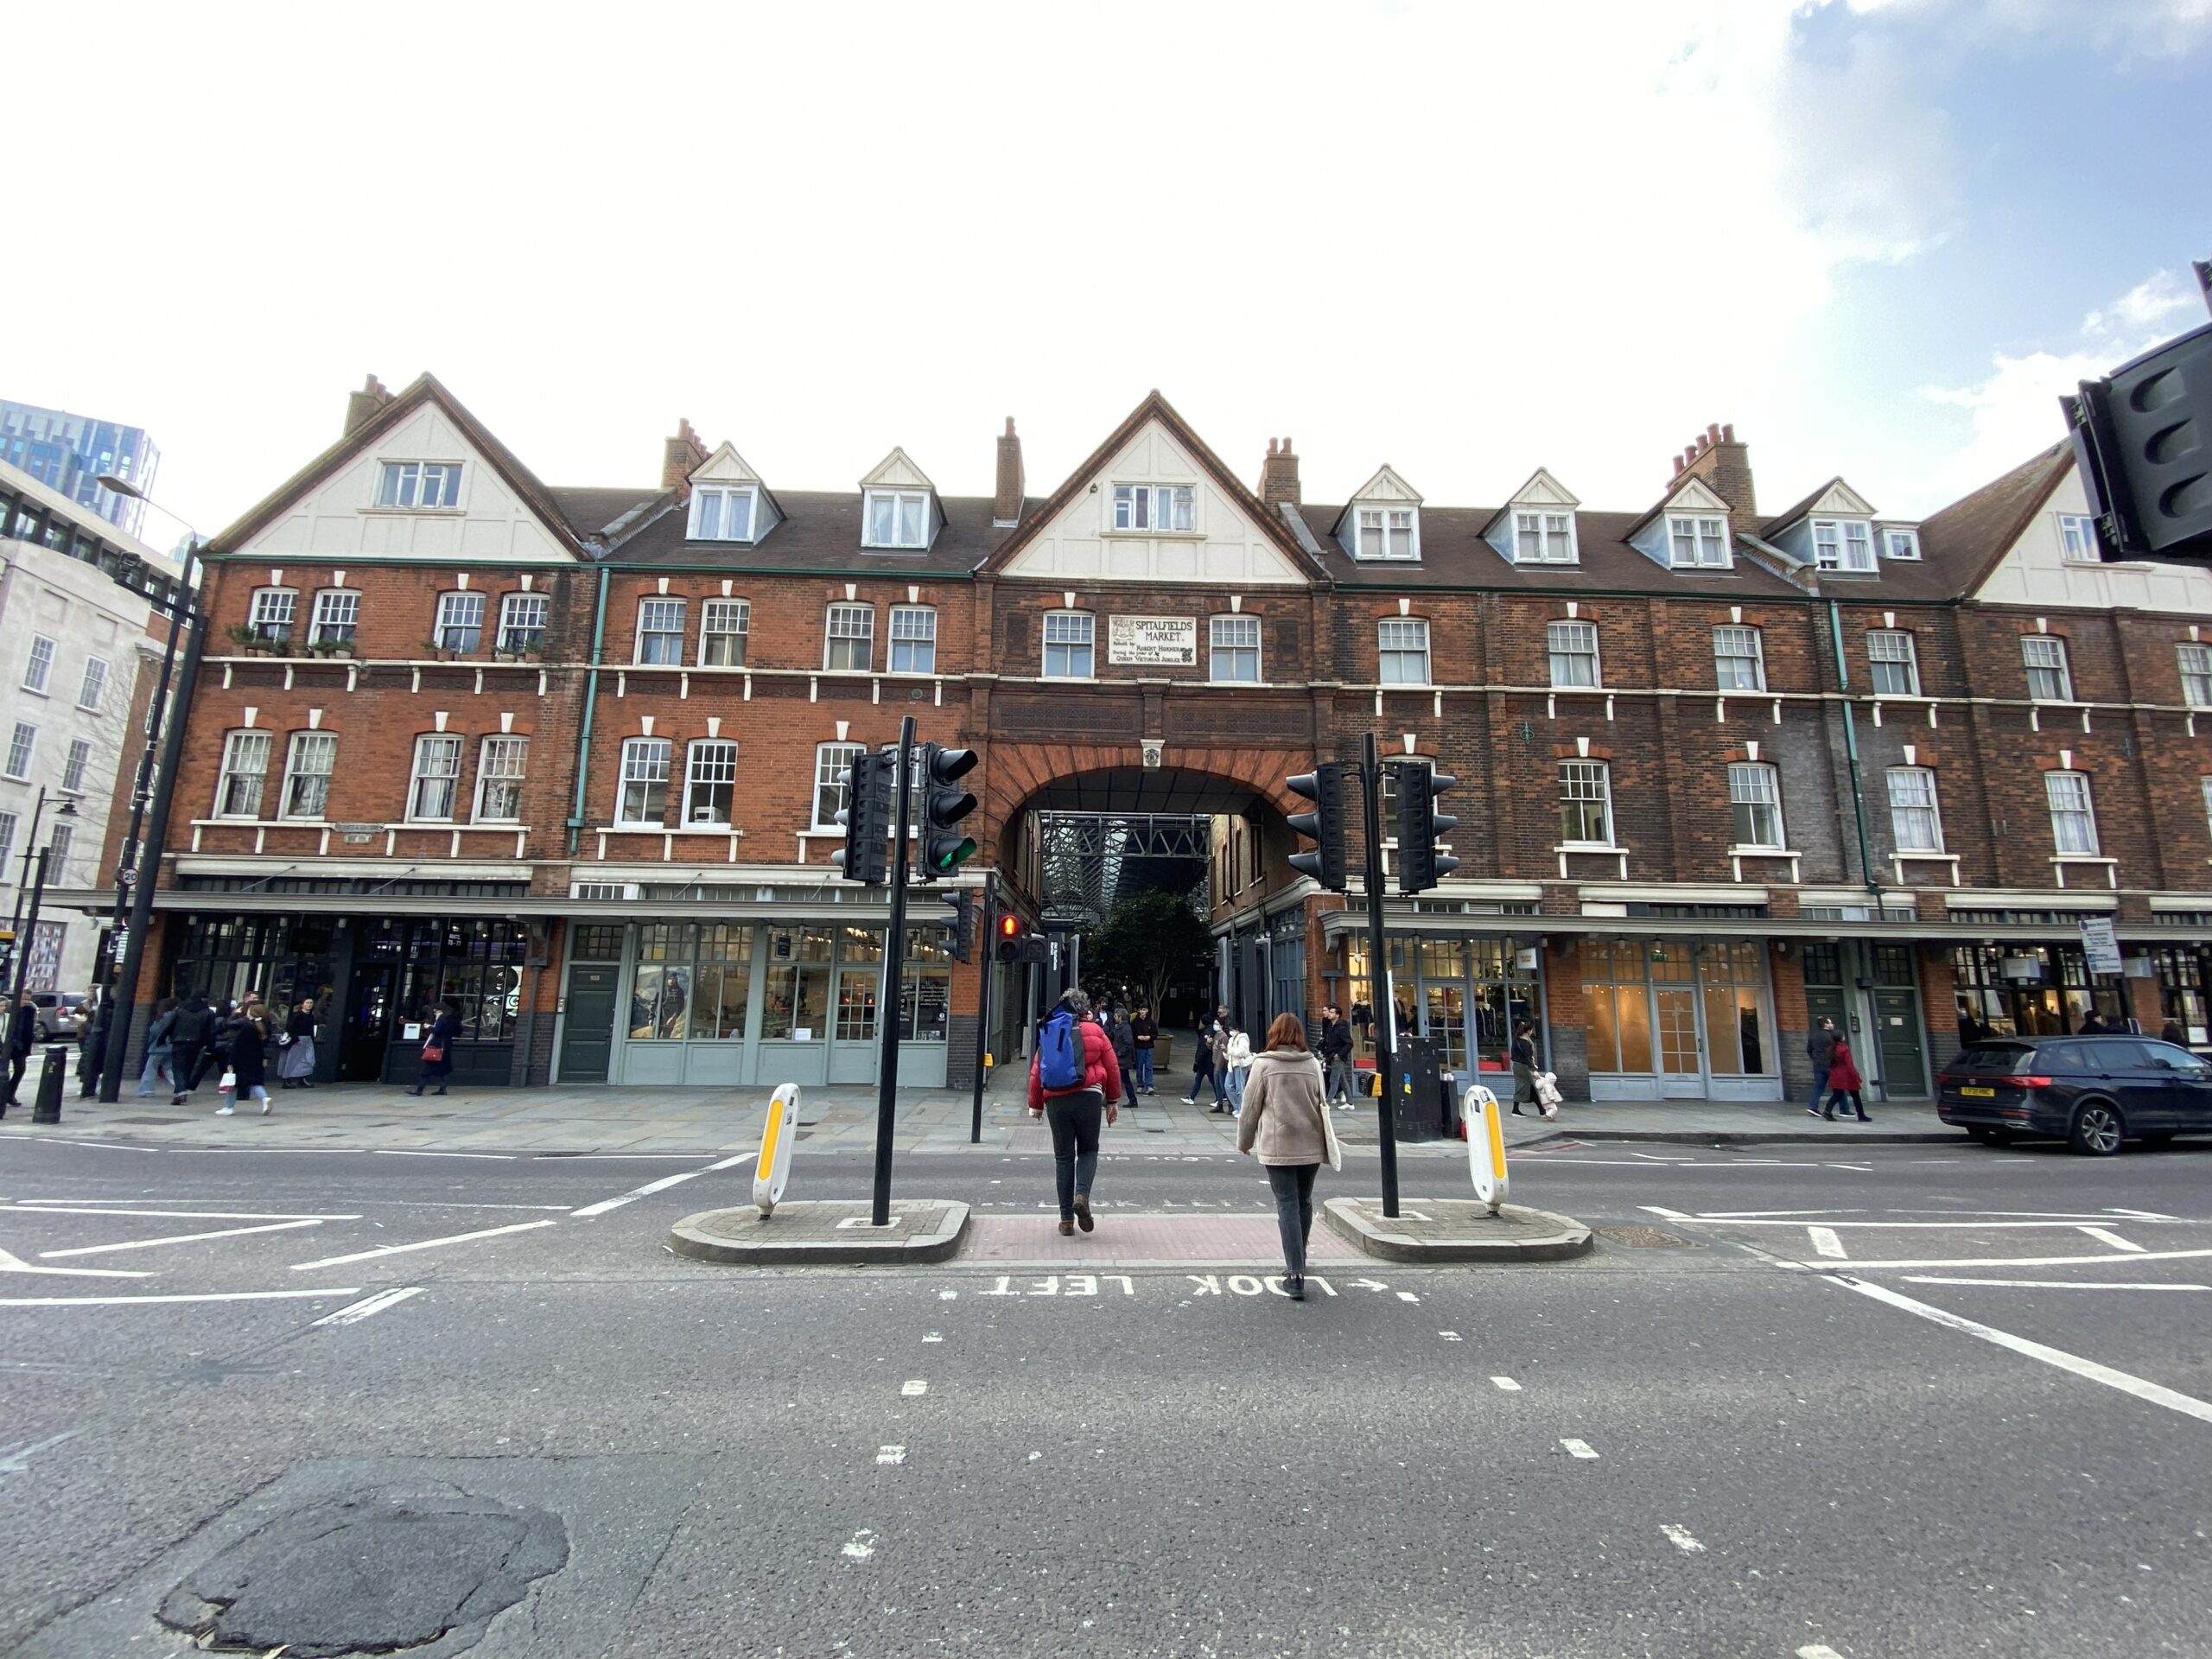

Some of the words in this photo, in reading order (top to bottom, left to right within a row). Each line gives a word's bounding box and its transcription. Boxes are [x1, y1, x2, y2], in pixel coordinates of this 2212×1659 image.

[1135, 621, 1192, 631] SPITALFIELDS
[1038, 1199, 1141, 1208] LOK
[979, 1275, 1135, 1296] LEFT
[1187, 1275, 1338, 1297] LOOK
